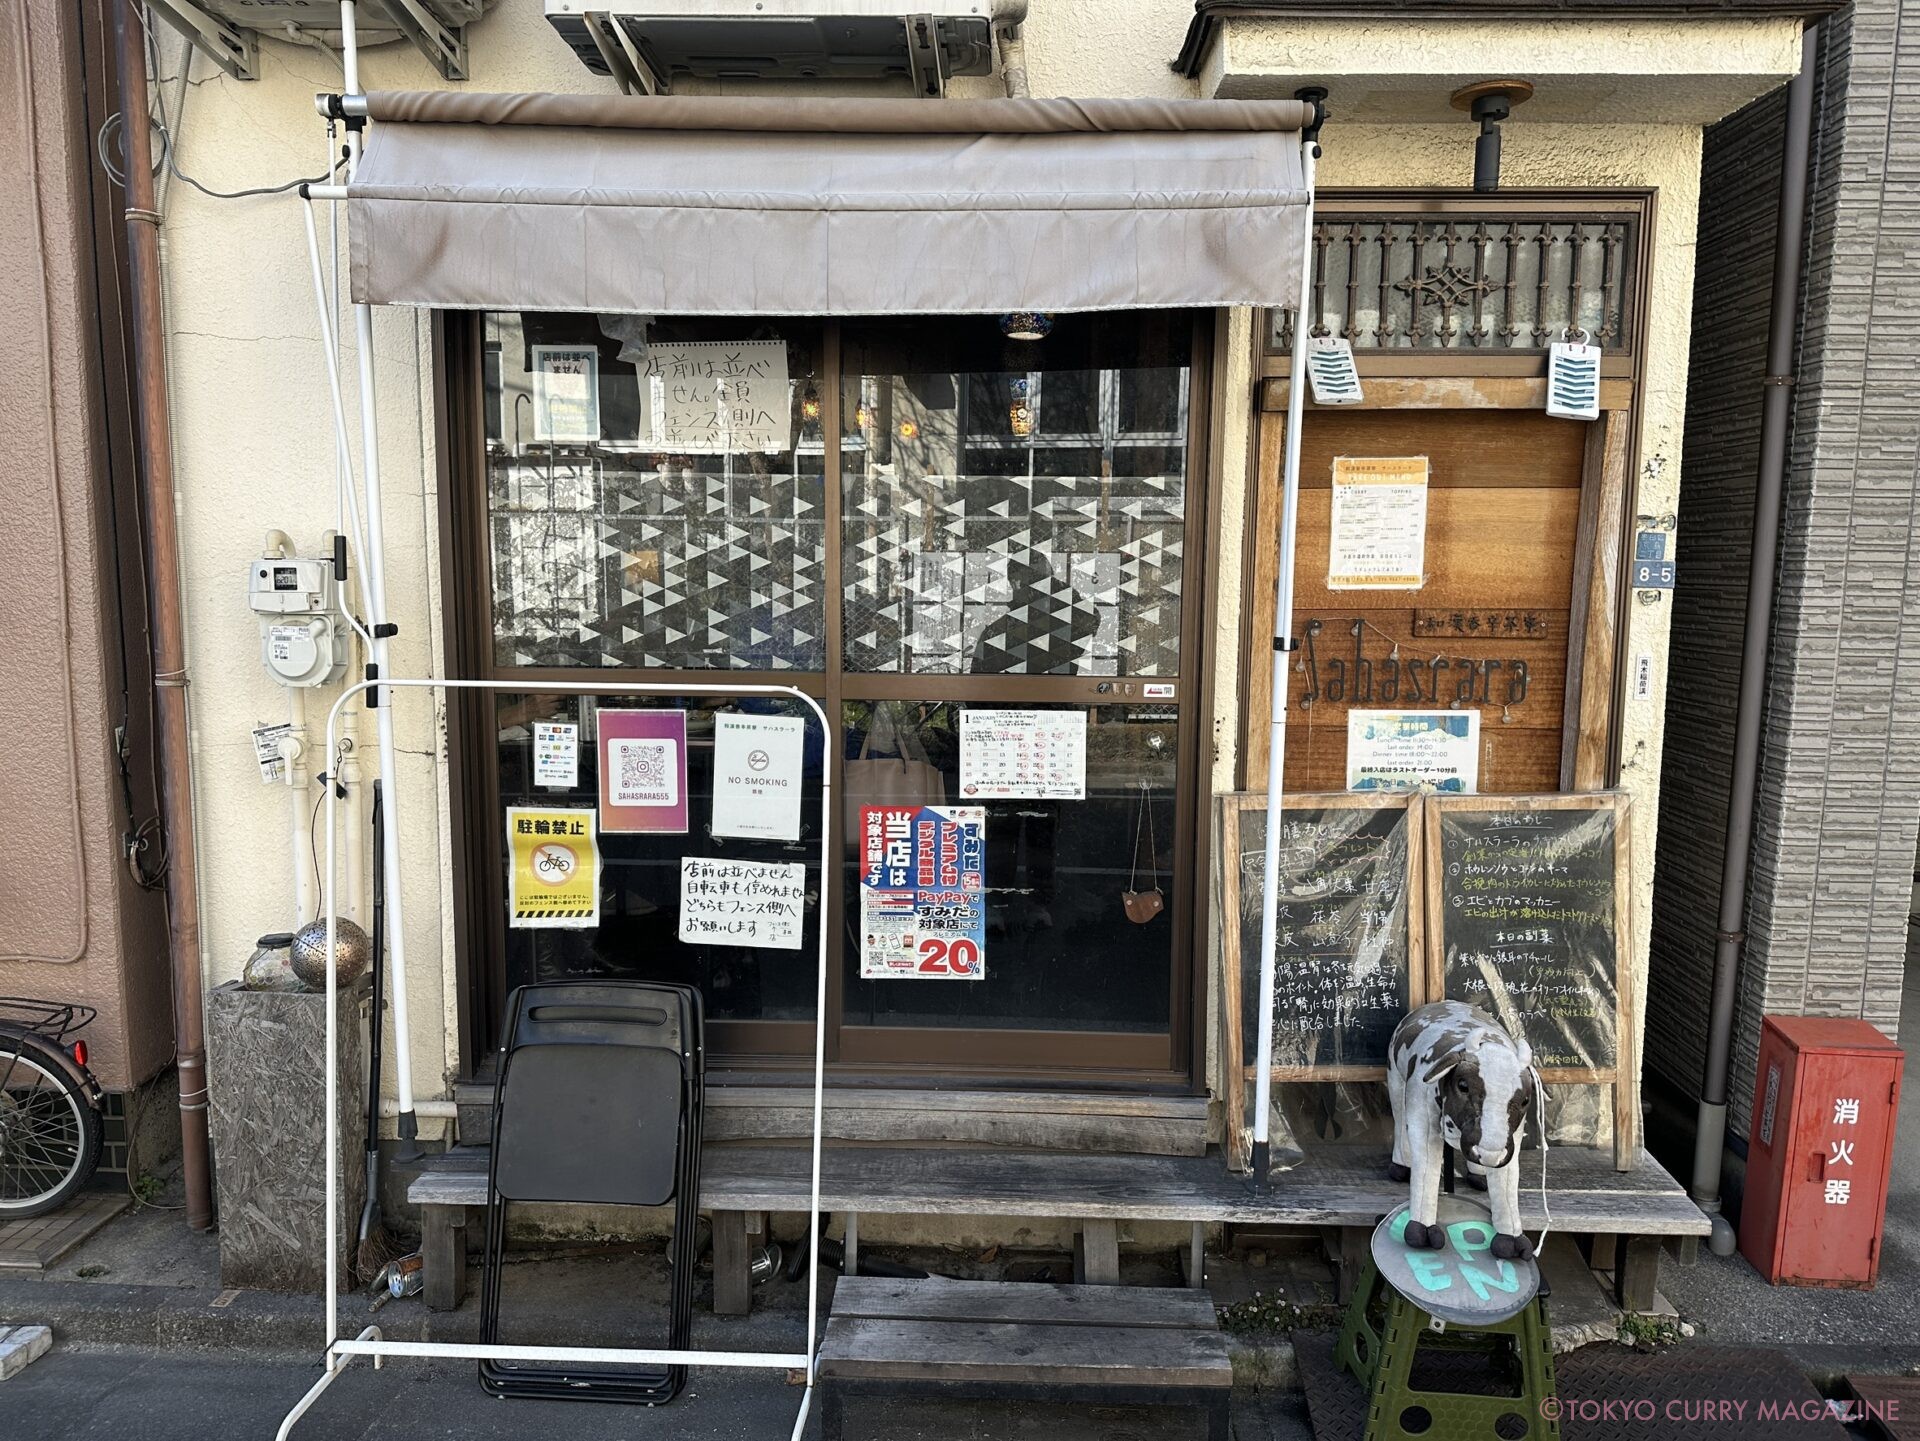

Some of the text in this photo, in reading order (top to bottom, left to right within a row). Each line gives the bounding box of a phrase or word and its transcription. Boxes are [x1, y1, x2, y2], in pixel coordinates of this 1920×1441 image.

[553, 366, 581, 374] ません
[644, 352, 770, 379] 店前は並べ
[658, 408, 776, 429] フェンス側へ
[1639, 567, 1672, 582] 8-5
[728, 776, 788, 787] NO SMOKING
[618, 792, 670, 801] SAHASRARA555
[517, 819, 585, 836] 駐輪禁止
[867, 811, 883, 886] 対象店舗です
[885, 811, 912, 886] 当店は
[941, 821, 958, 887] プレミアム付
[963, 823, 980, 871] すみだ
[684, 860, 794, 880] 店前は並べません
[687, 879, 806, 899] 自転車も停めれません
[686, 898, 797, 918] どちらもフェンス側へ
[918, 906, 979, 917] すみだの
[685, 917, 758, 937] お願いします
[918, 919, 978, 930] 対象店にて
[1495, 929, 1554, 944] 本日の副菜
[1824, 1098, 1860, 1204] 消火器
